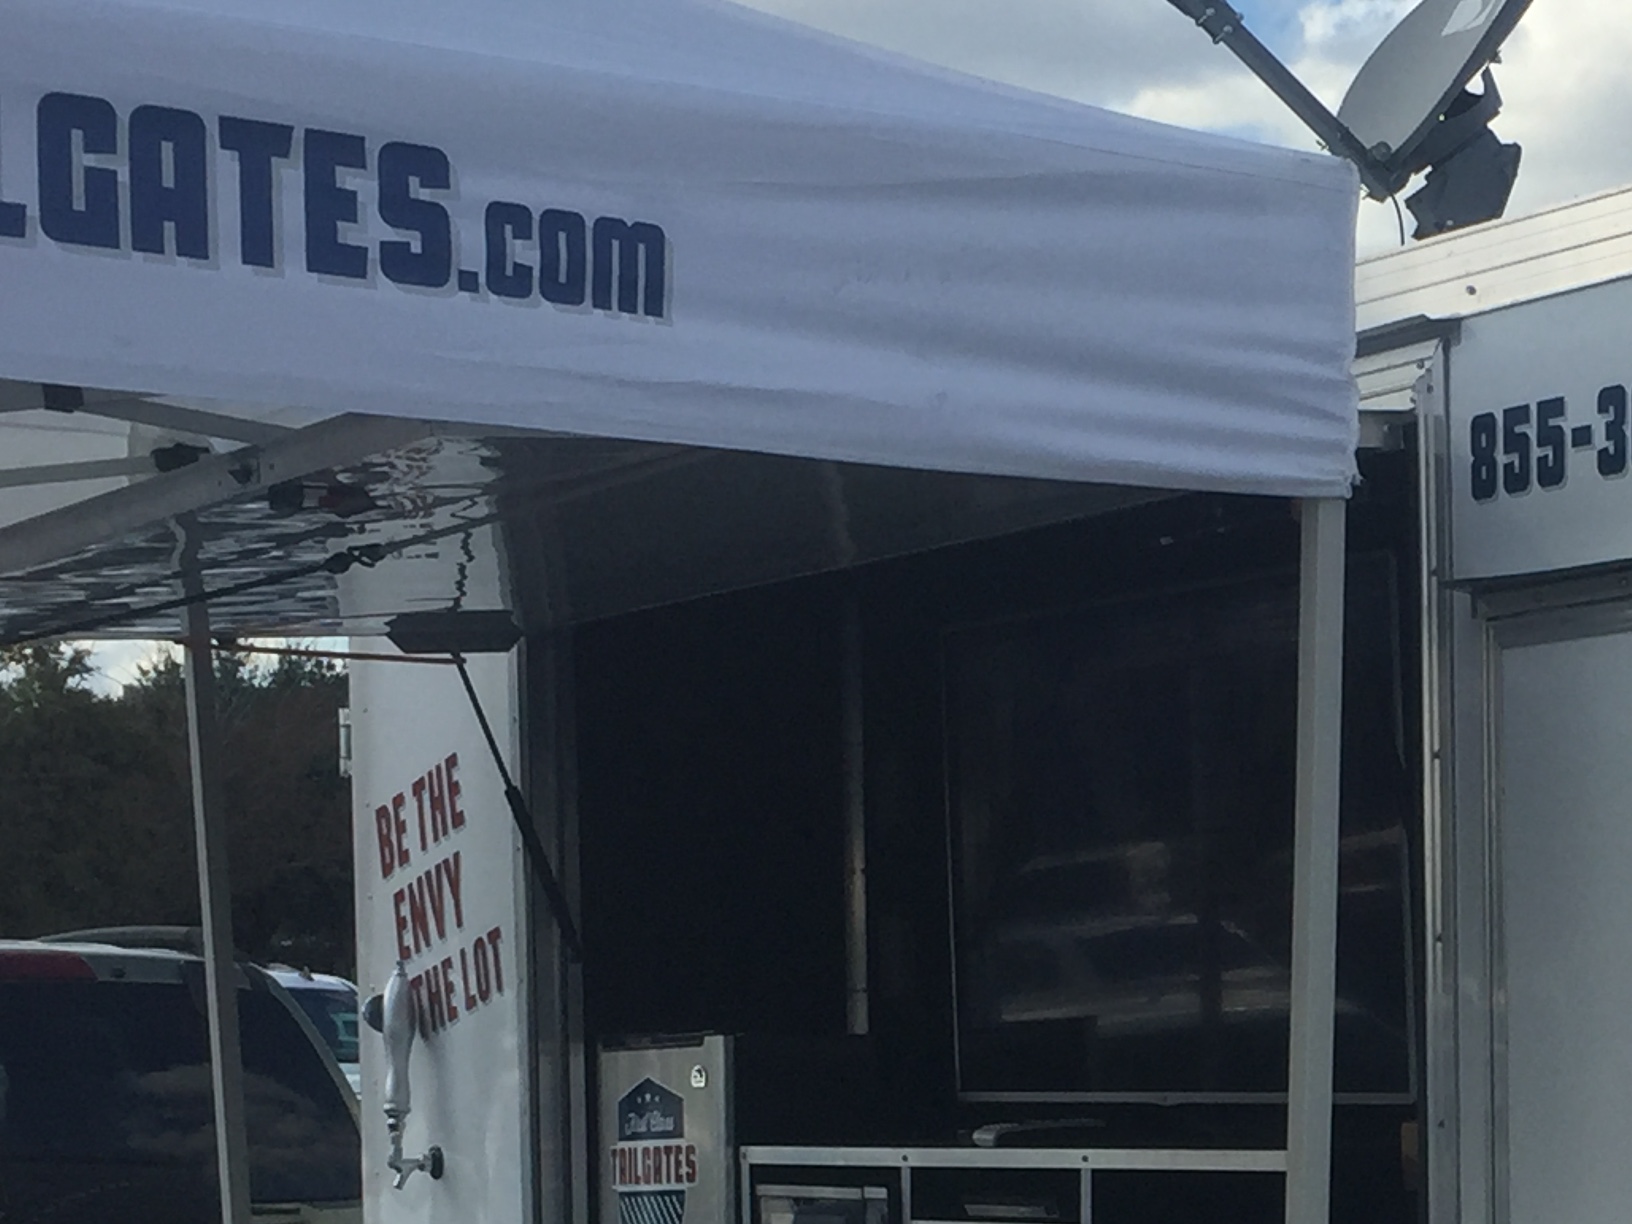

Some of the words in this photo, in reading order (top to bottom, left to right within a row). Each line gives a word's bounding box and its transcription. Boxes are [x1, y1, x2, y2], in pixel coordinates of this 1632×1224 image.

[375, 792, 411, 880] BE
[411, 752, 466, 852] THE
[393, 851, 464, 962] ENVY
[408, 955, 459, 1042] THE
[459, 926, 505, 1012] LOT
[610, 1144, 698, 1186] TAILGATES
